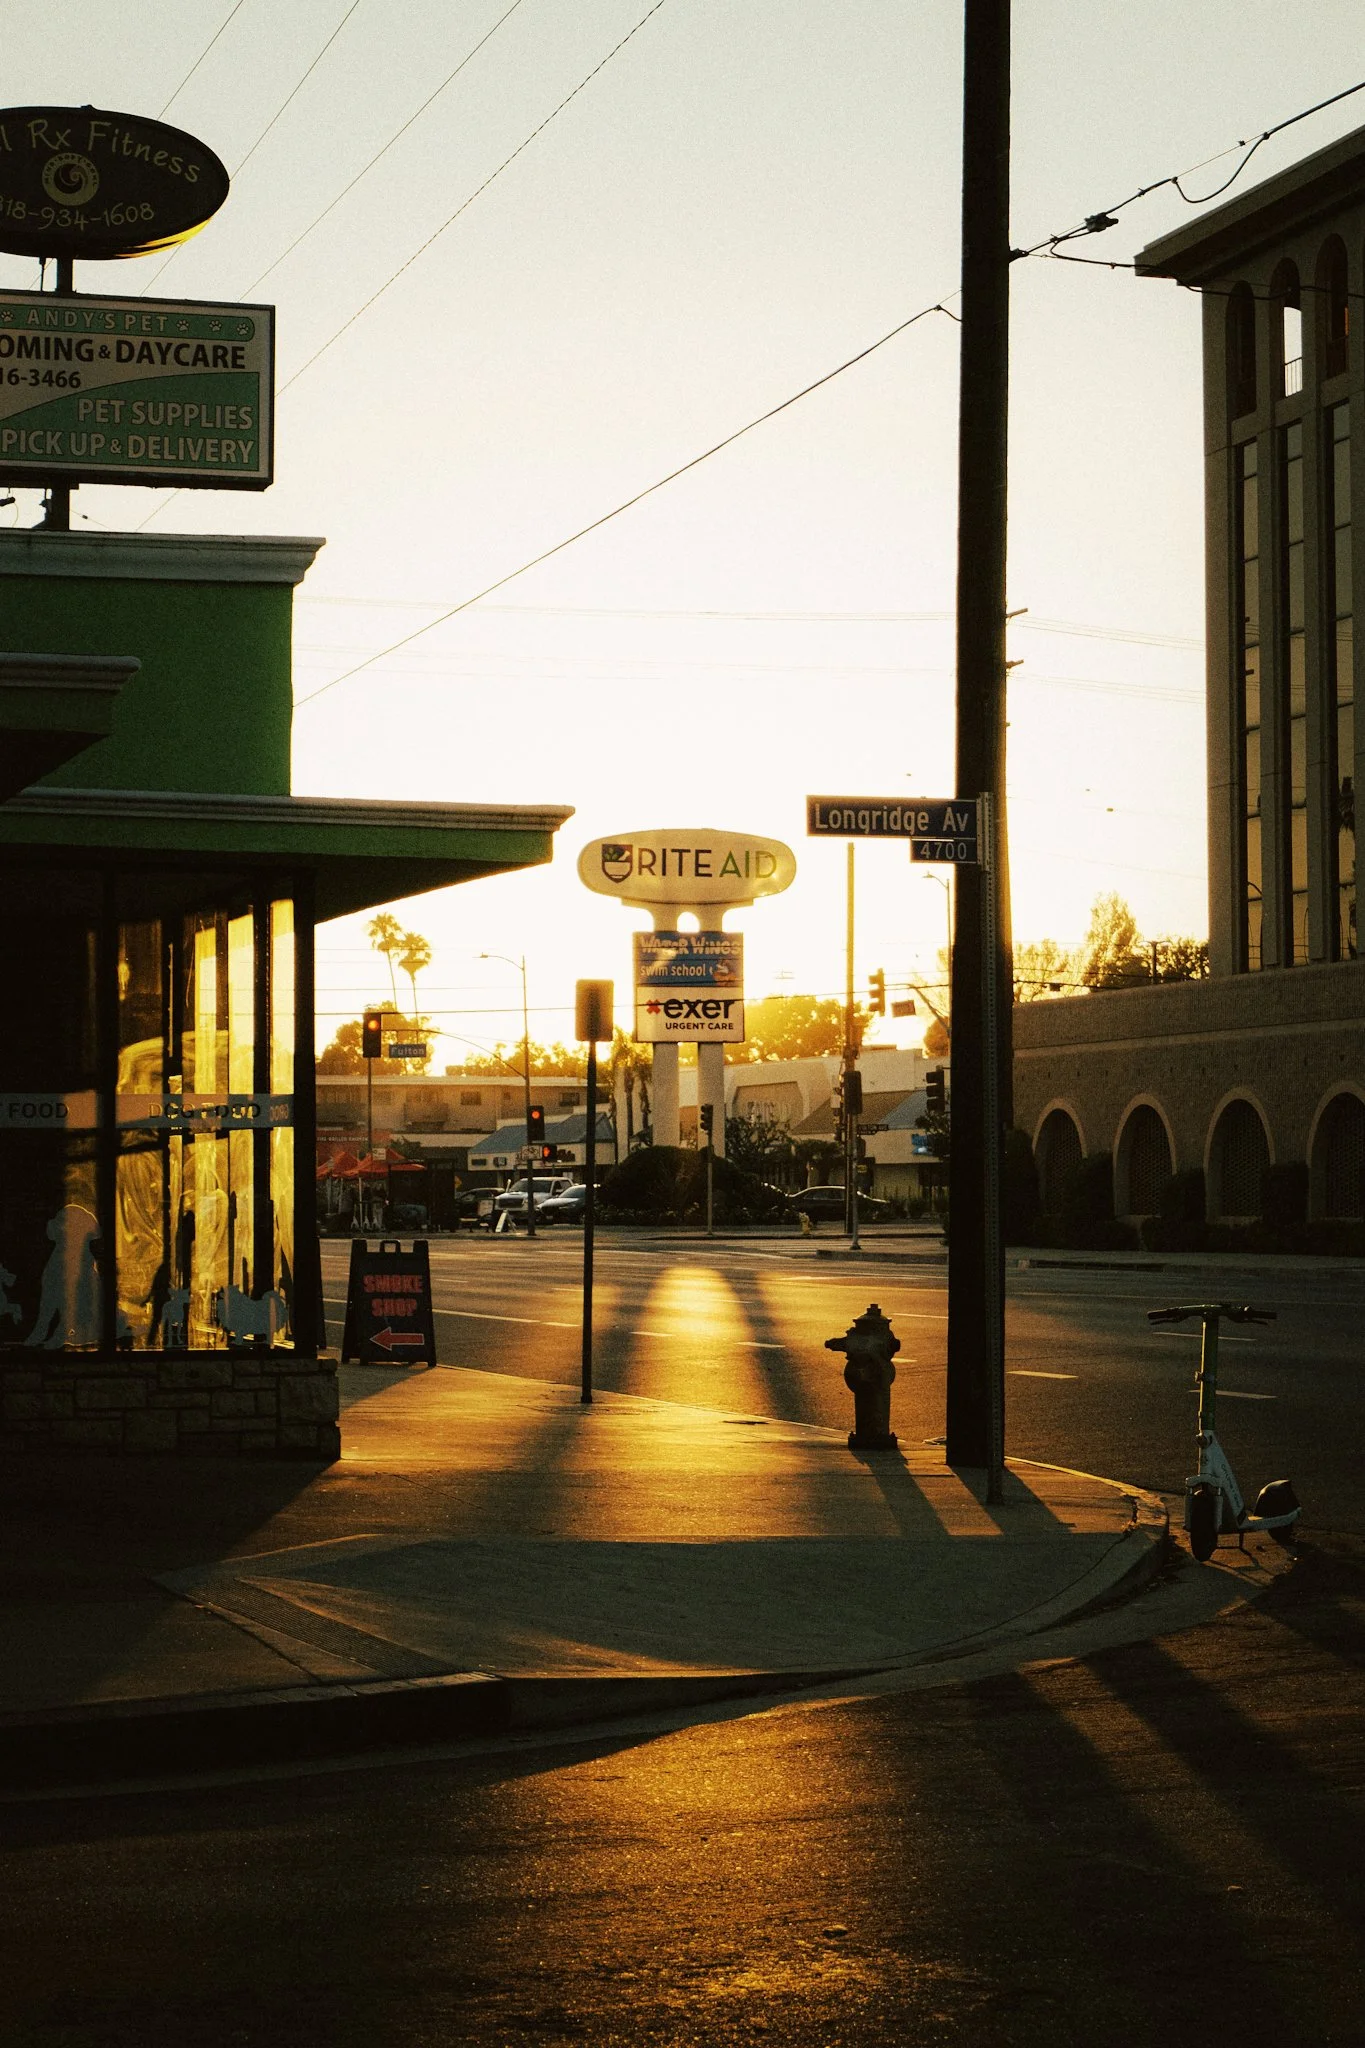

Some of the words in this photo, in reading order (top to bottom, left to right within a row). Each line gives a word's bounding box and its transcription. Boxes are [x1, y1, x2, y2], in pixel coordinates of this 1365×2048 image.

[27, 118, 72, 150] Rx
[88, 121, 200, 184] Fitness
[27, 308, 116, 330] ANDY'S
[124, 314, 169, 333] PET
[116, 339, 246, 369] DAYCARE
[77, 398, 125, 424] PET
[131, 401, 253, 430] SUPPLIES
[2, 429, 63, 456] PICK
[70, 432, 105, 457] UP
[110, 438, 122, 454] &
[127, 435, 254, 464] DELIVERY
[815, 804, 929, 836] Longridge
[942, 806, 969, 832] Av
[920, 842, 967, 860] 4700
[638, 847, 713, 878] RITE
[719, 850, 778, 879] AID
[640, 965, 668, 976] swim
[671, 963, 706, 976] school
[663, 998, 735, 1020] exer
[665, 1022, 705, 1030] URGENT
[708, 1022, 734, 1030] CARE
[391, 1047, 425, 1056] Fulton
[8, 1102, 68, 1119] FOOD
[148, 1102, 195, 1119] DOG
[201, 1102, 261, 1119] FOOD
[362, 1274, 423, 1293] SMOKE
[371, 1298, 417, 1317] SHOP
